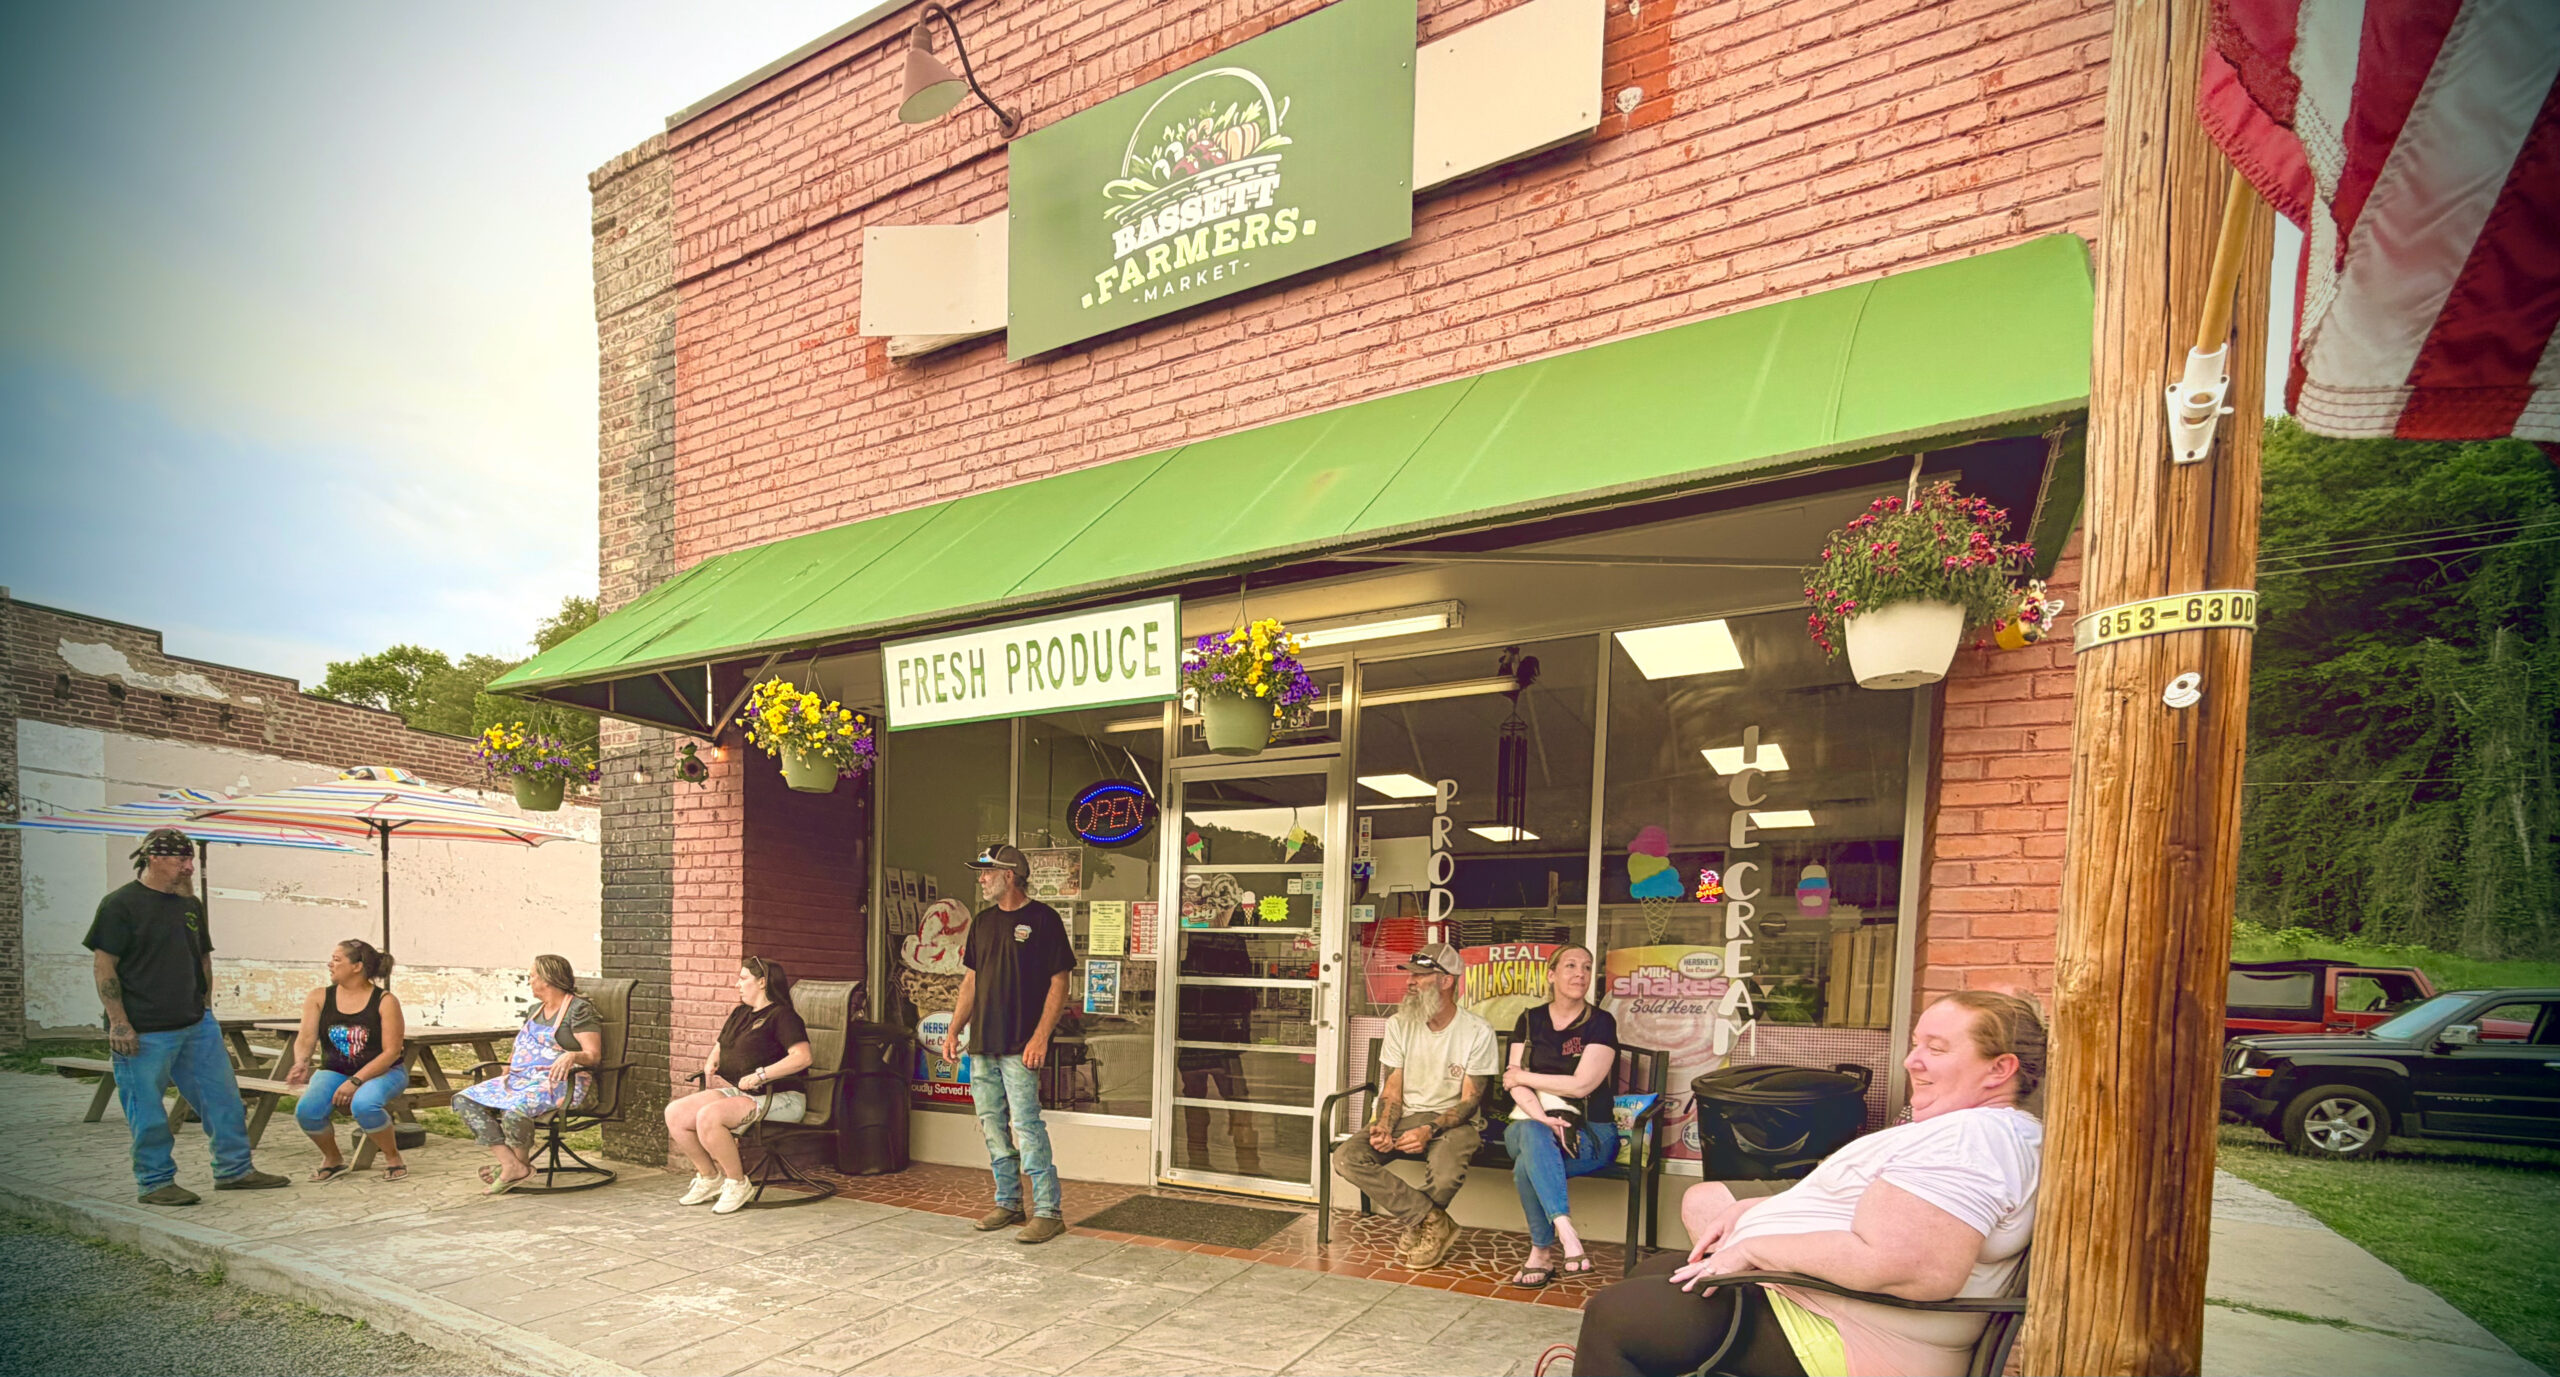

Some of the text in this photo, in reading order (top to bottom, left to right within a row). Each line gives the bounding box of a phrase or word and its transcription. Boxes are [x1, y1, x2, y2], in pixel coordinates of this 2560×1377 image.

[1112, 174, 1280, 260] BASSETT
[2098, 596, 2253, 638] 853-6300
[898, 621, 1161, 707] FRESH PRODUCE
[1075, 794, 1146, 832] OPEN
[1427, 779, 1458, 945] PRODU
[1713, 725, 1767, 1057] ICE CREAM
[1489, 945, 1546, 961] REAL
[1683, 958, 1719, 966] HERSHEY'S
[1464, 960, 1549, 1009] MILKSHAK
[1613, 971, 1729, 997] shakes
[1630, 999, 1713, 1014] Sold Here!
[923, 1022, 949, 1034] HERSH
[925, 1035, 936, 1046] Ice
[911, 1083, 933, 1096] oudly
[934, 1083, 963, 1095] Served
[1684, 1132, 1699, 1140] RE
